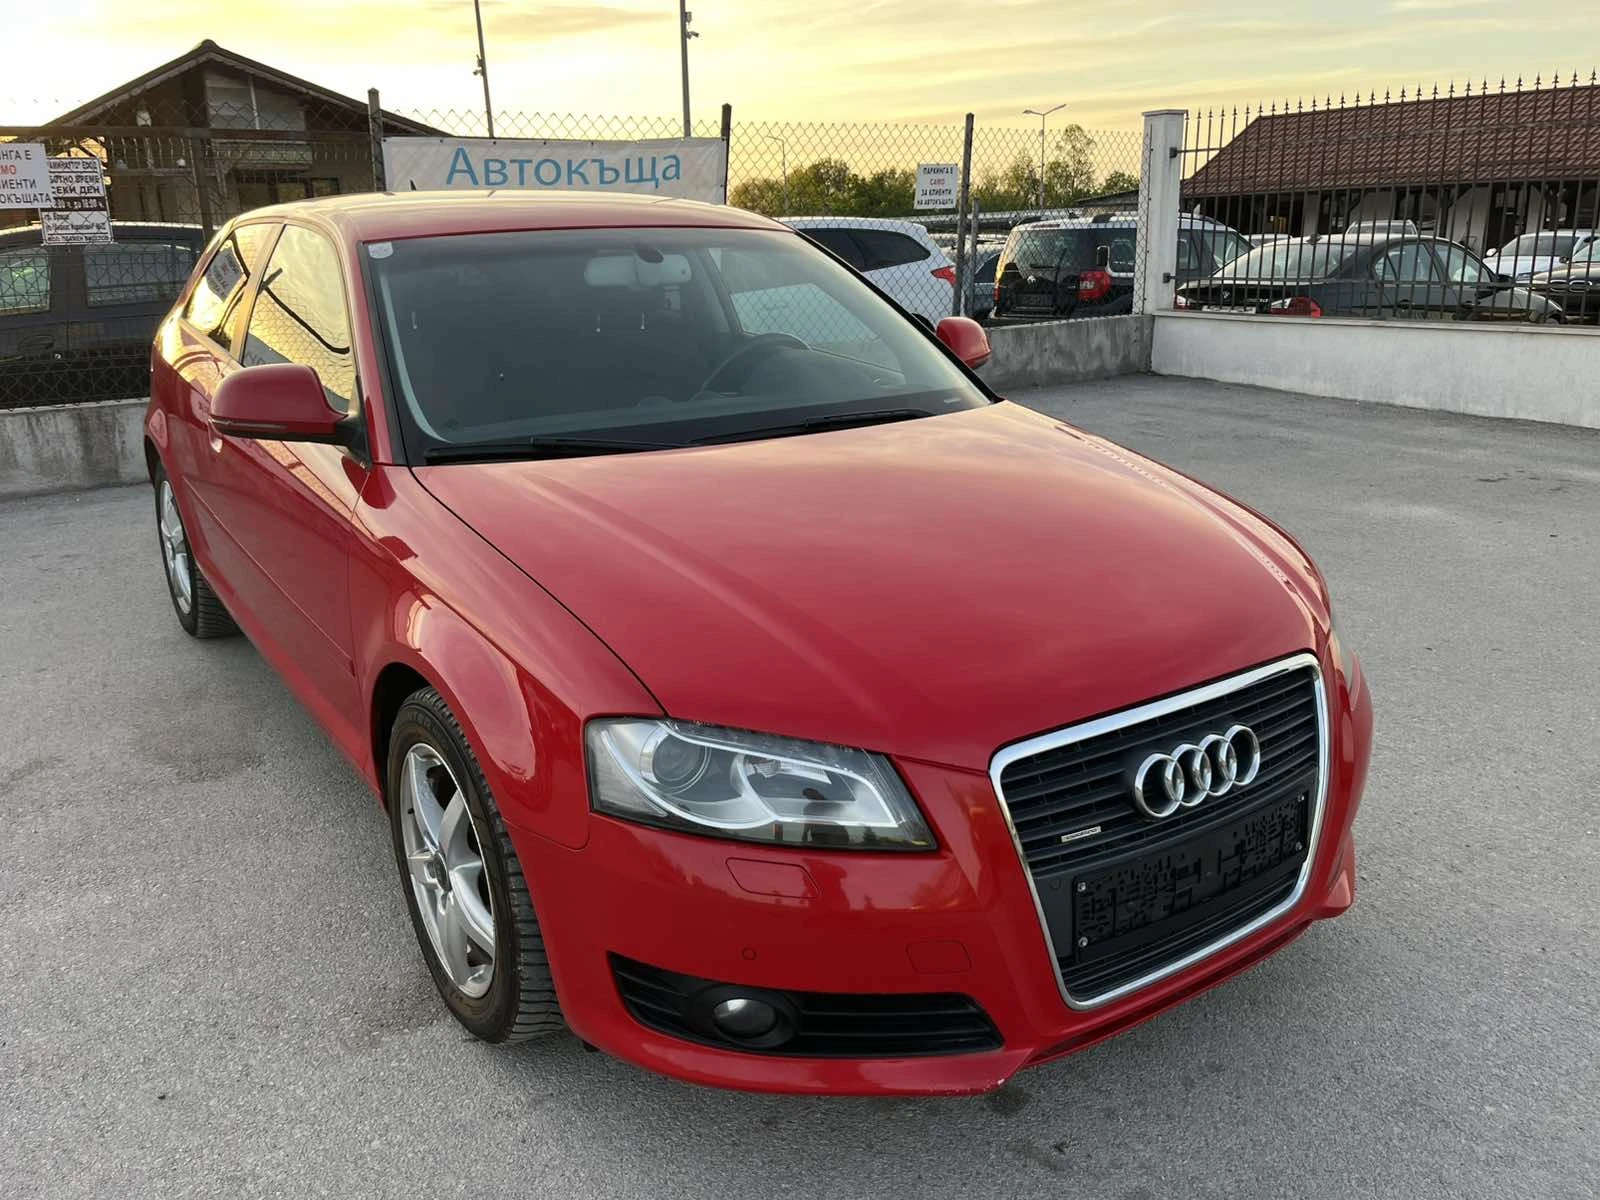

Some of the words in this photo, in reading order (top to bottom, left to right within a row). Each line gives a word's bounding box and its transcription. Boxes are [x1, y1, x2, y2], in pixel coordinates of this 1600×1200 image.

[0, 149, 22, 160] НГА
[25, 149, 32, 160] Е
[0, 164, 16, 175] МО
[446, 147, 682, 188] Автокъща
[0, 178, 37, 189] ИЕНТИ
[80, 185, 100, 195] ДЕН
